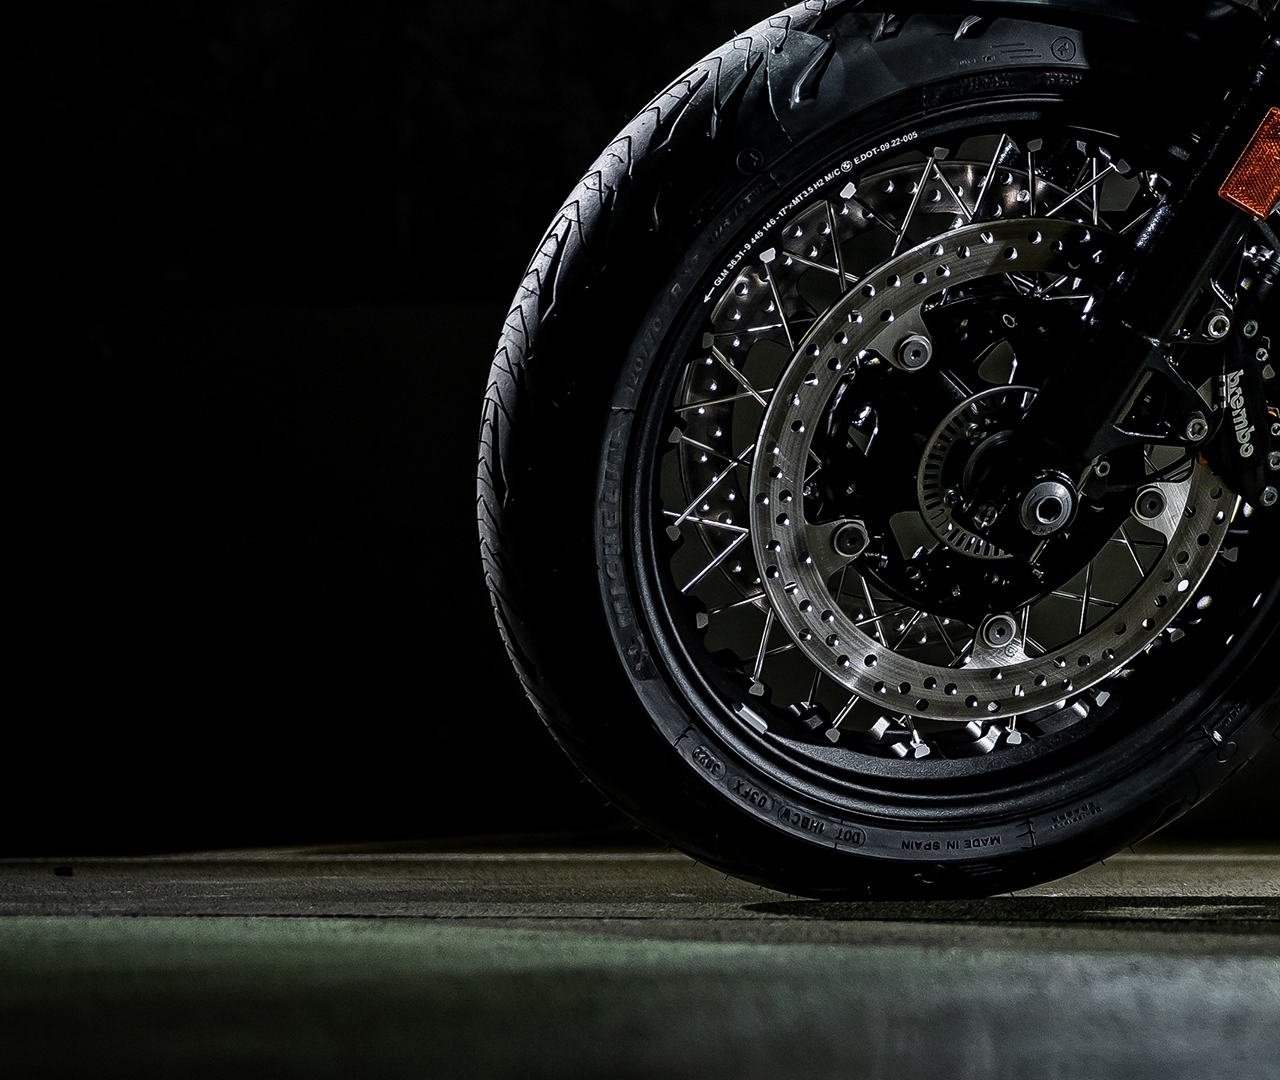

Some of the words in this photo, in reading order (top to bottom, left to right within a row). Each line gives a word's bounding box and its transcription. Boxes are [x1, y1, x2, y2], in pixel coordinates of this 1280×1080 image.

[714, 267, 730, 286] GLM
[750, 230, 764, 244] 445
[812, 179, 825, 190] H2
[824, 167, 841, 182] M/C
[1228, 369, 1255, 458] brembo
[731, 778, 768, 809] 03FX
[834, 827, 861, 845] DOT
[899, 838, 940, 851] SPAIN
[945, 839, 958, 850] IN
[962, 834, 1000, 849] MADE
